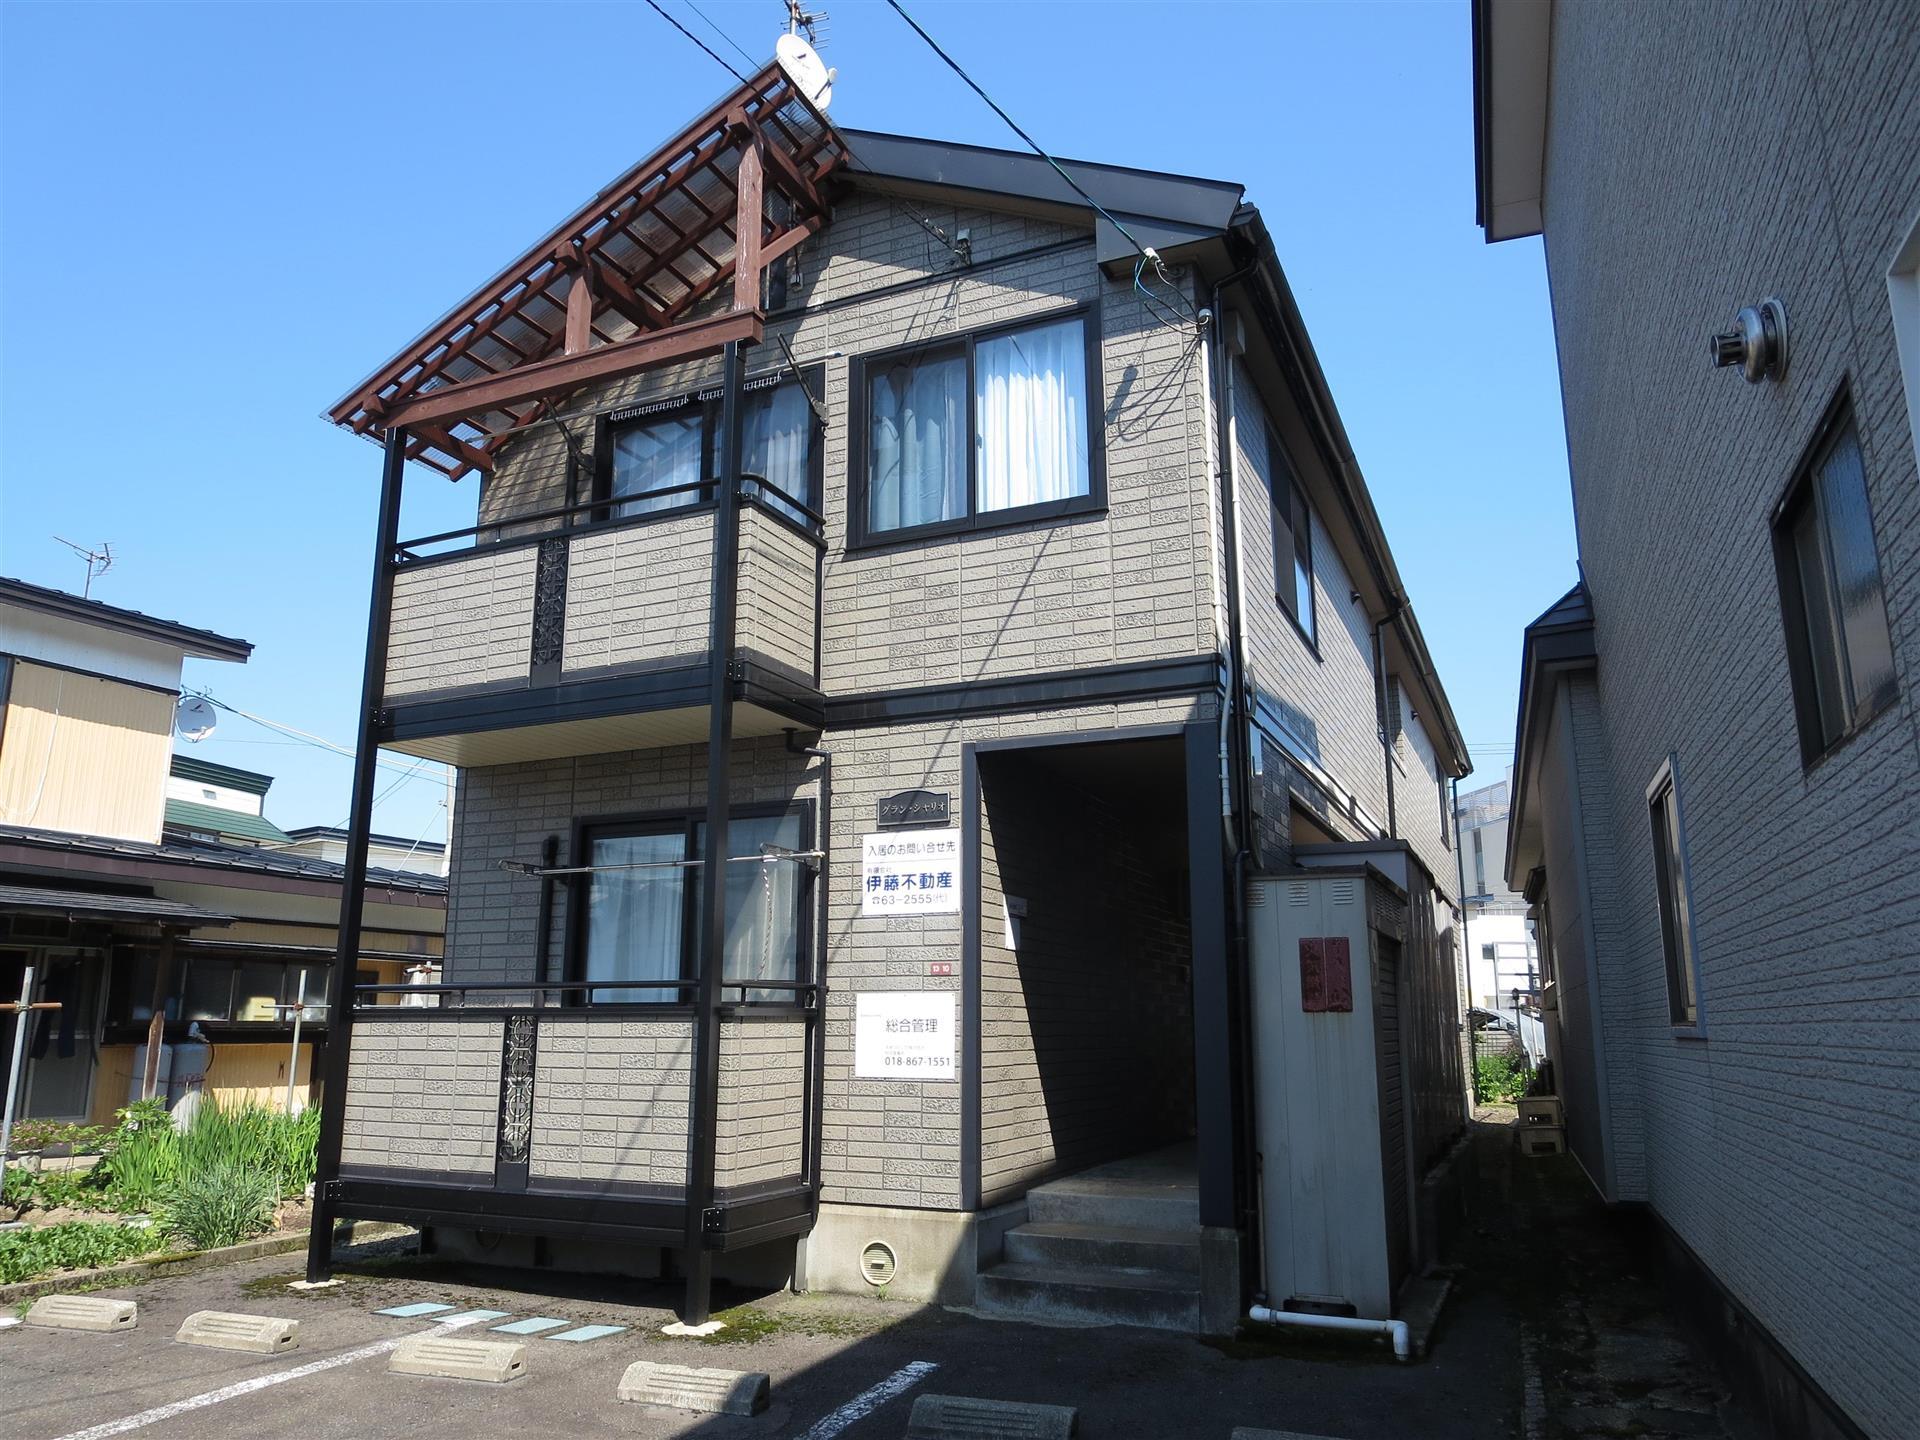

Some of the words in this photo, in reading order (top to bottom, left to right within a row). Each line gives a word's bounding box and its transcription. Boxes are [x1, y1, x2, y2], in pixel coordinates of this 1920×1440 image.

[881, 801, 946, 816] グラン・シャリオ
[868, 841, 956, 857] 入居のお問い合せ先
[866, 871, 953, 893] 伊藤不動産
[885, 1018, 938, 1033] 総合管理
[884, 1056, 950, 1067] 018-867-1551
